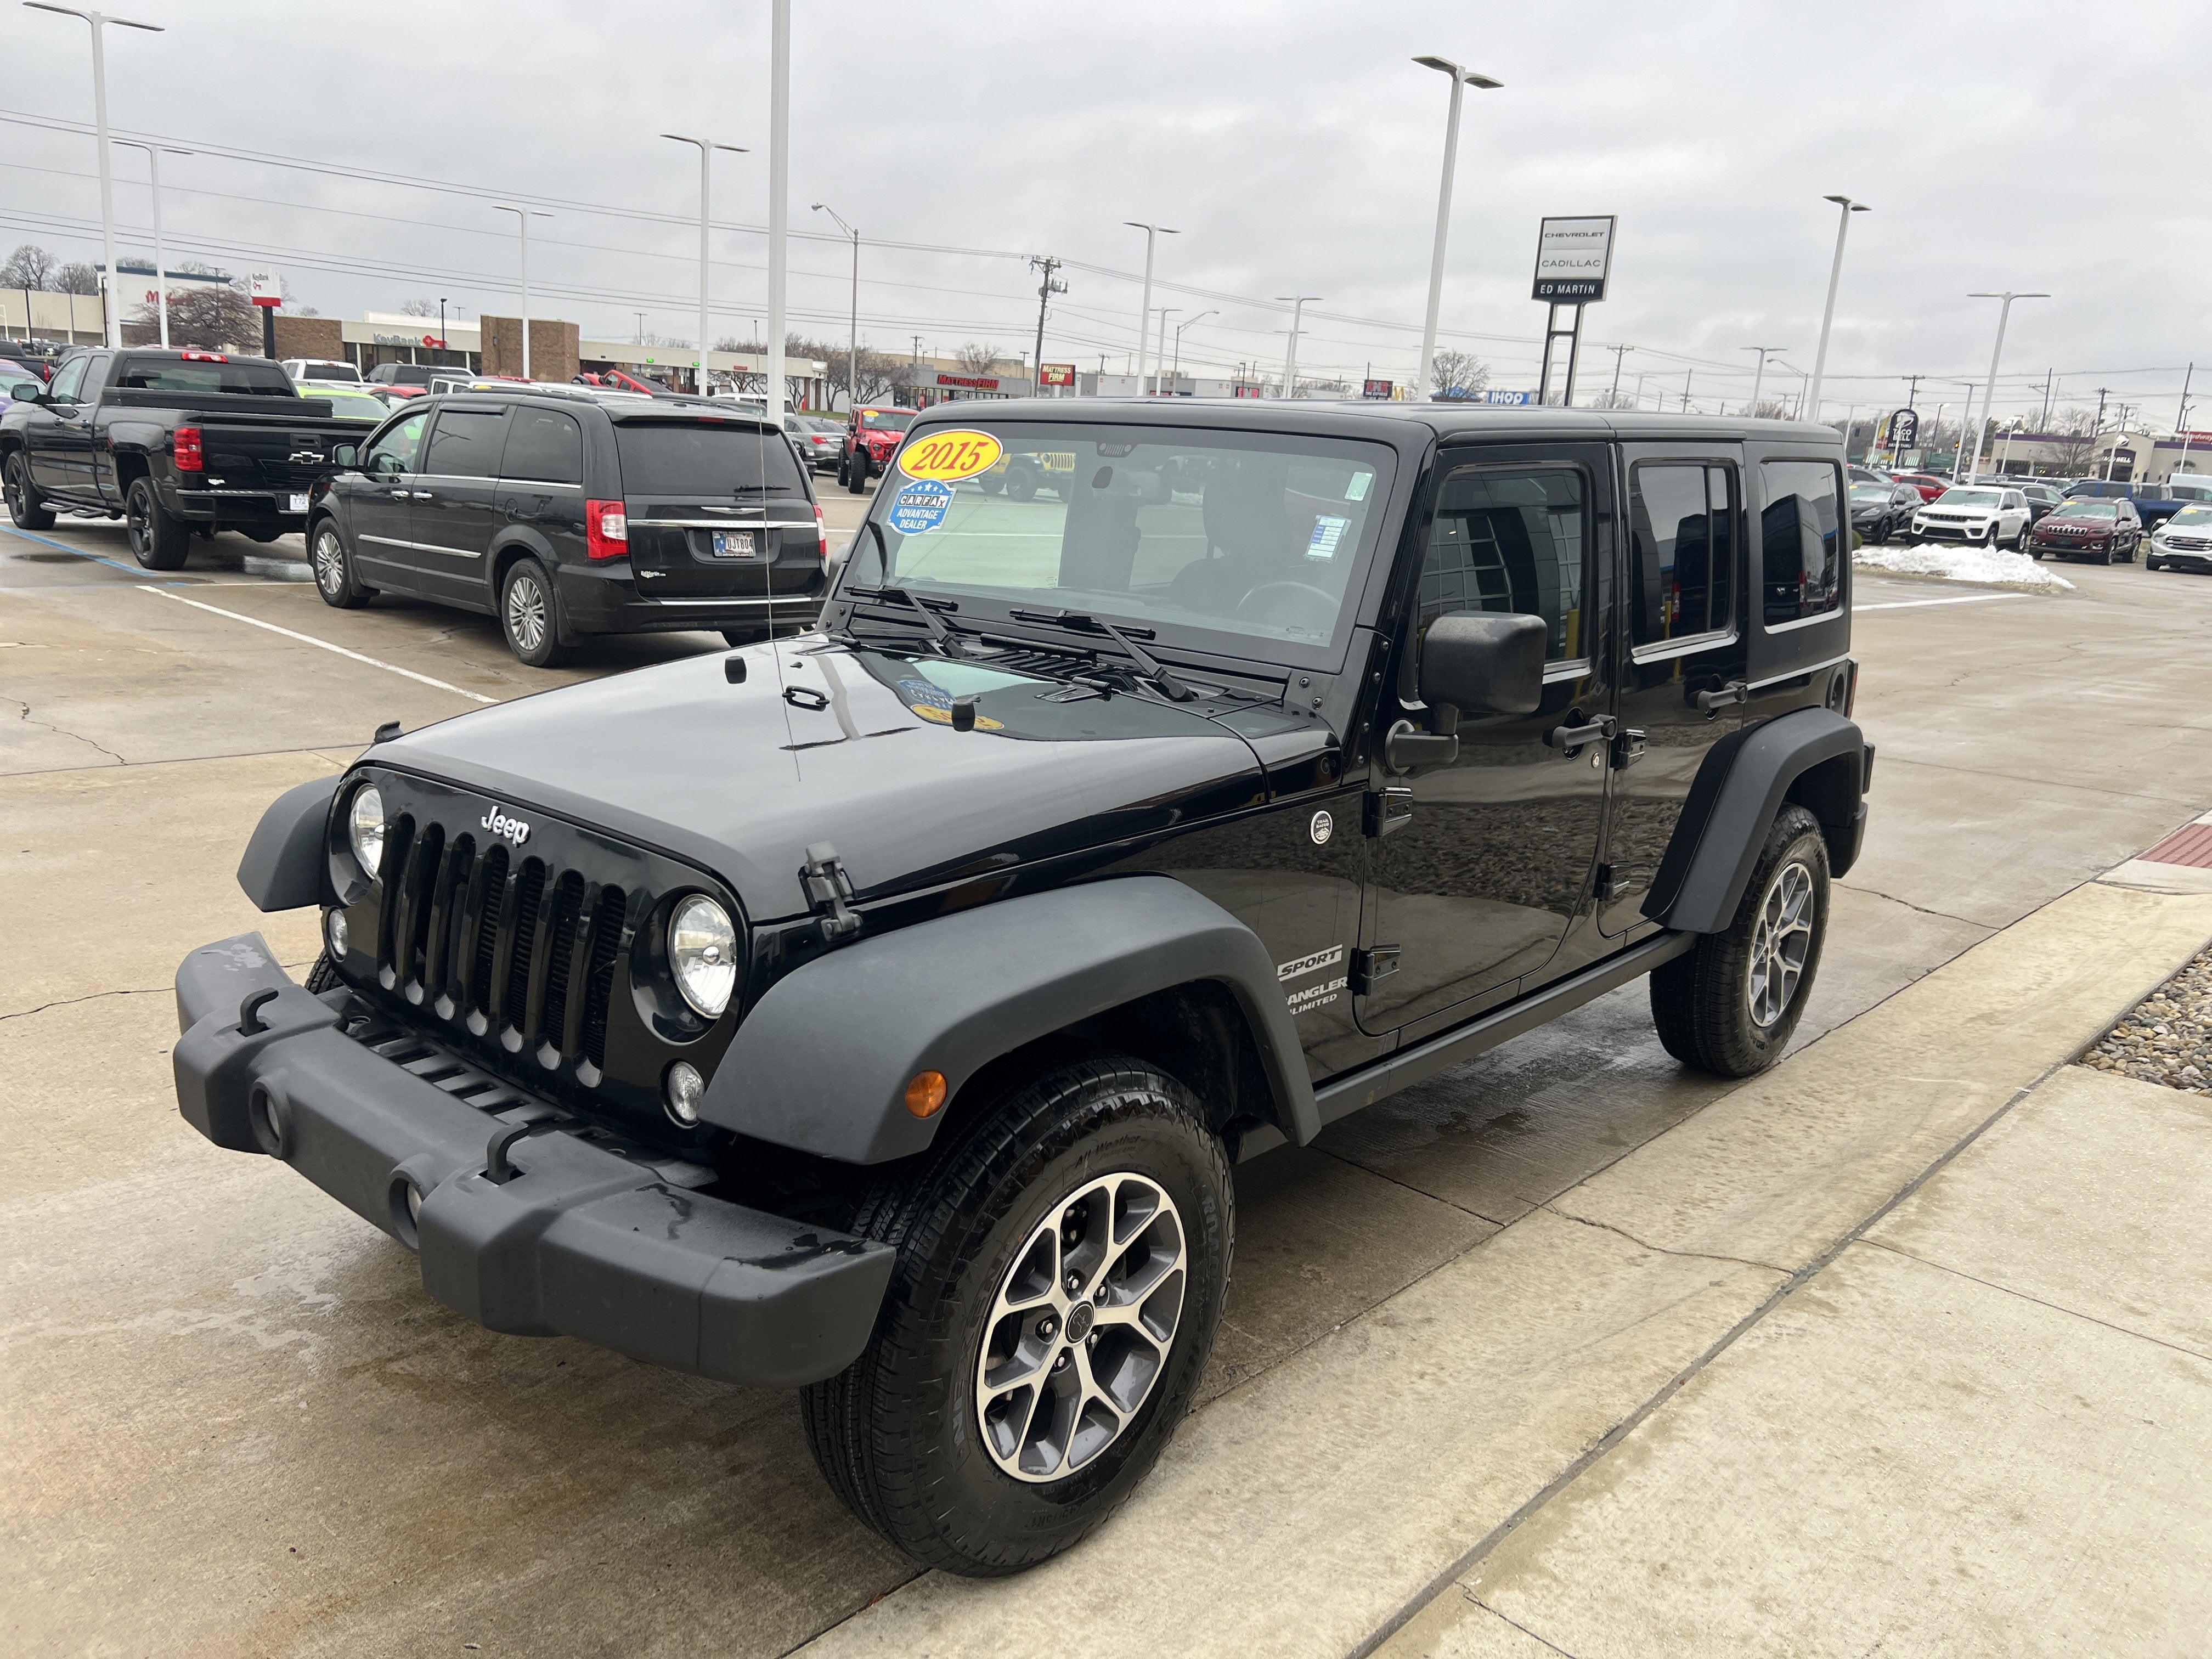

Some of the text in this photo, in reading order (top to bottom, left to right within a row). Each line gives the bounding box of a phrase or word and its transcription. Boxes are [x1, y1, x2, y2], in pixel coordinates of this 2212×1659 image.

[1540, 284, 1595, 295] ED MARTIN
[373, 333, 422, 346] KeyBank
[1042, 365, 1071, 374] MATTRESS
[938, 374, 999, 389] MATTRESS FIRM
[910, 442, 990, 471] 2015
[899, 494, 946, 508] CARFAX
[896, 509, 939, 520] ADVANTAGE
[900, 519, 928, 530] DEALER
[727, 538, 754, 549] UJT804
[481, 805, 530, 845] Jeep
[1280, 950, 1338, 974] SPORT
[1286, 976, 1348, 1006] ANGLER
[1290, 993, 1338, 1015] LIMITED
